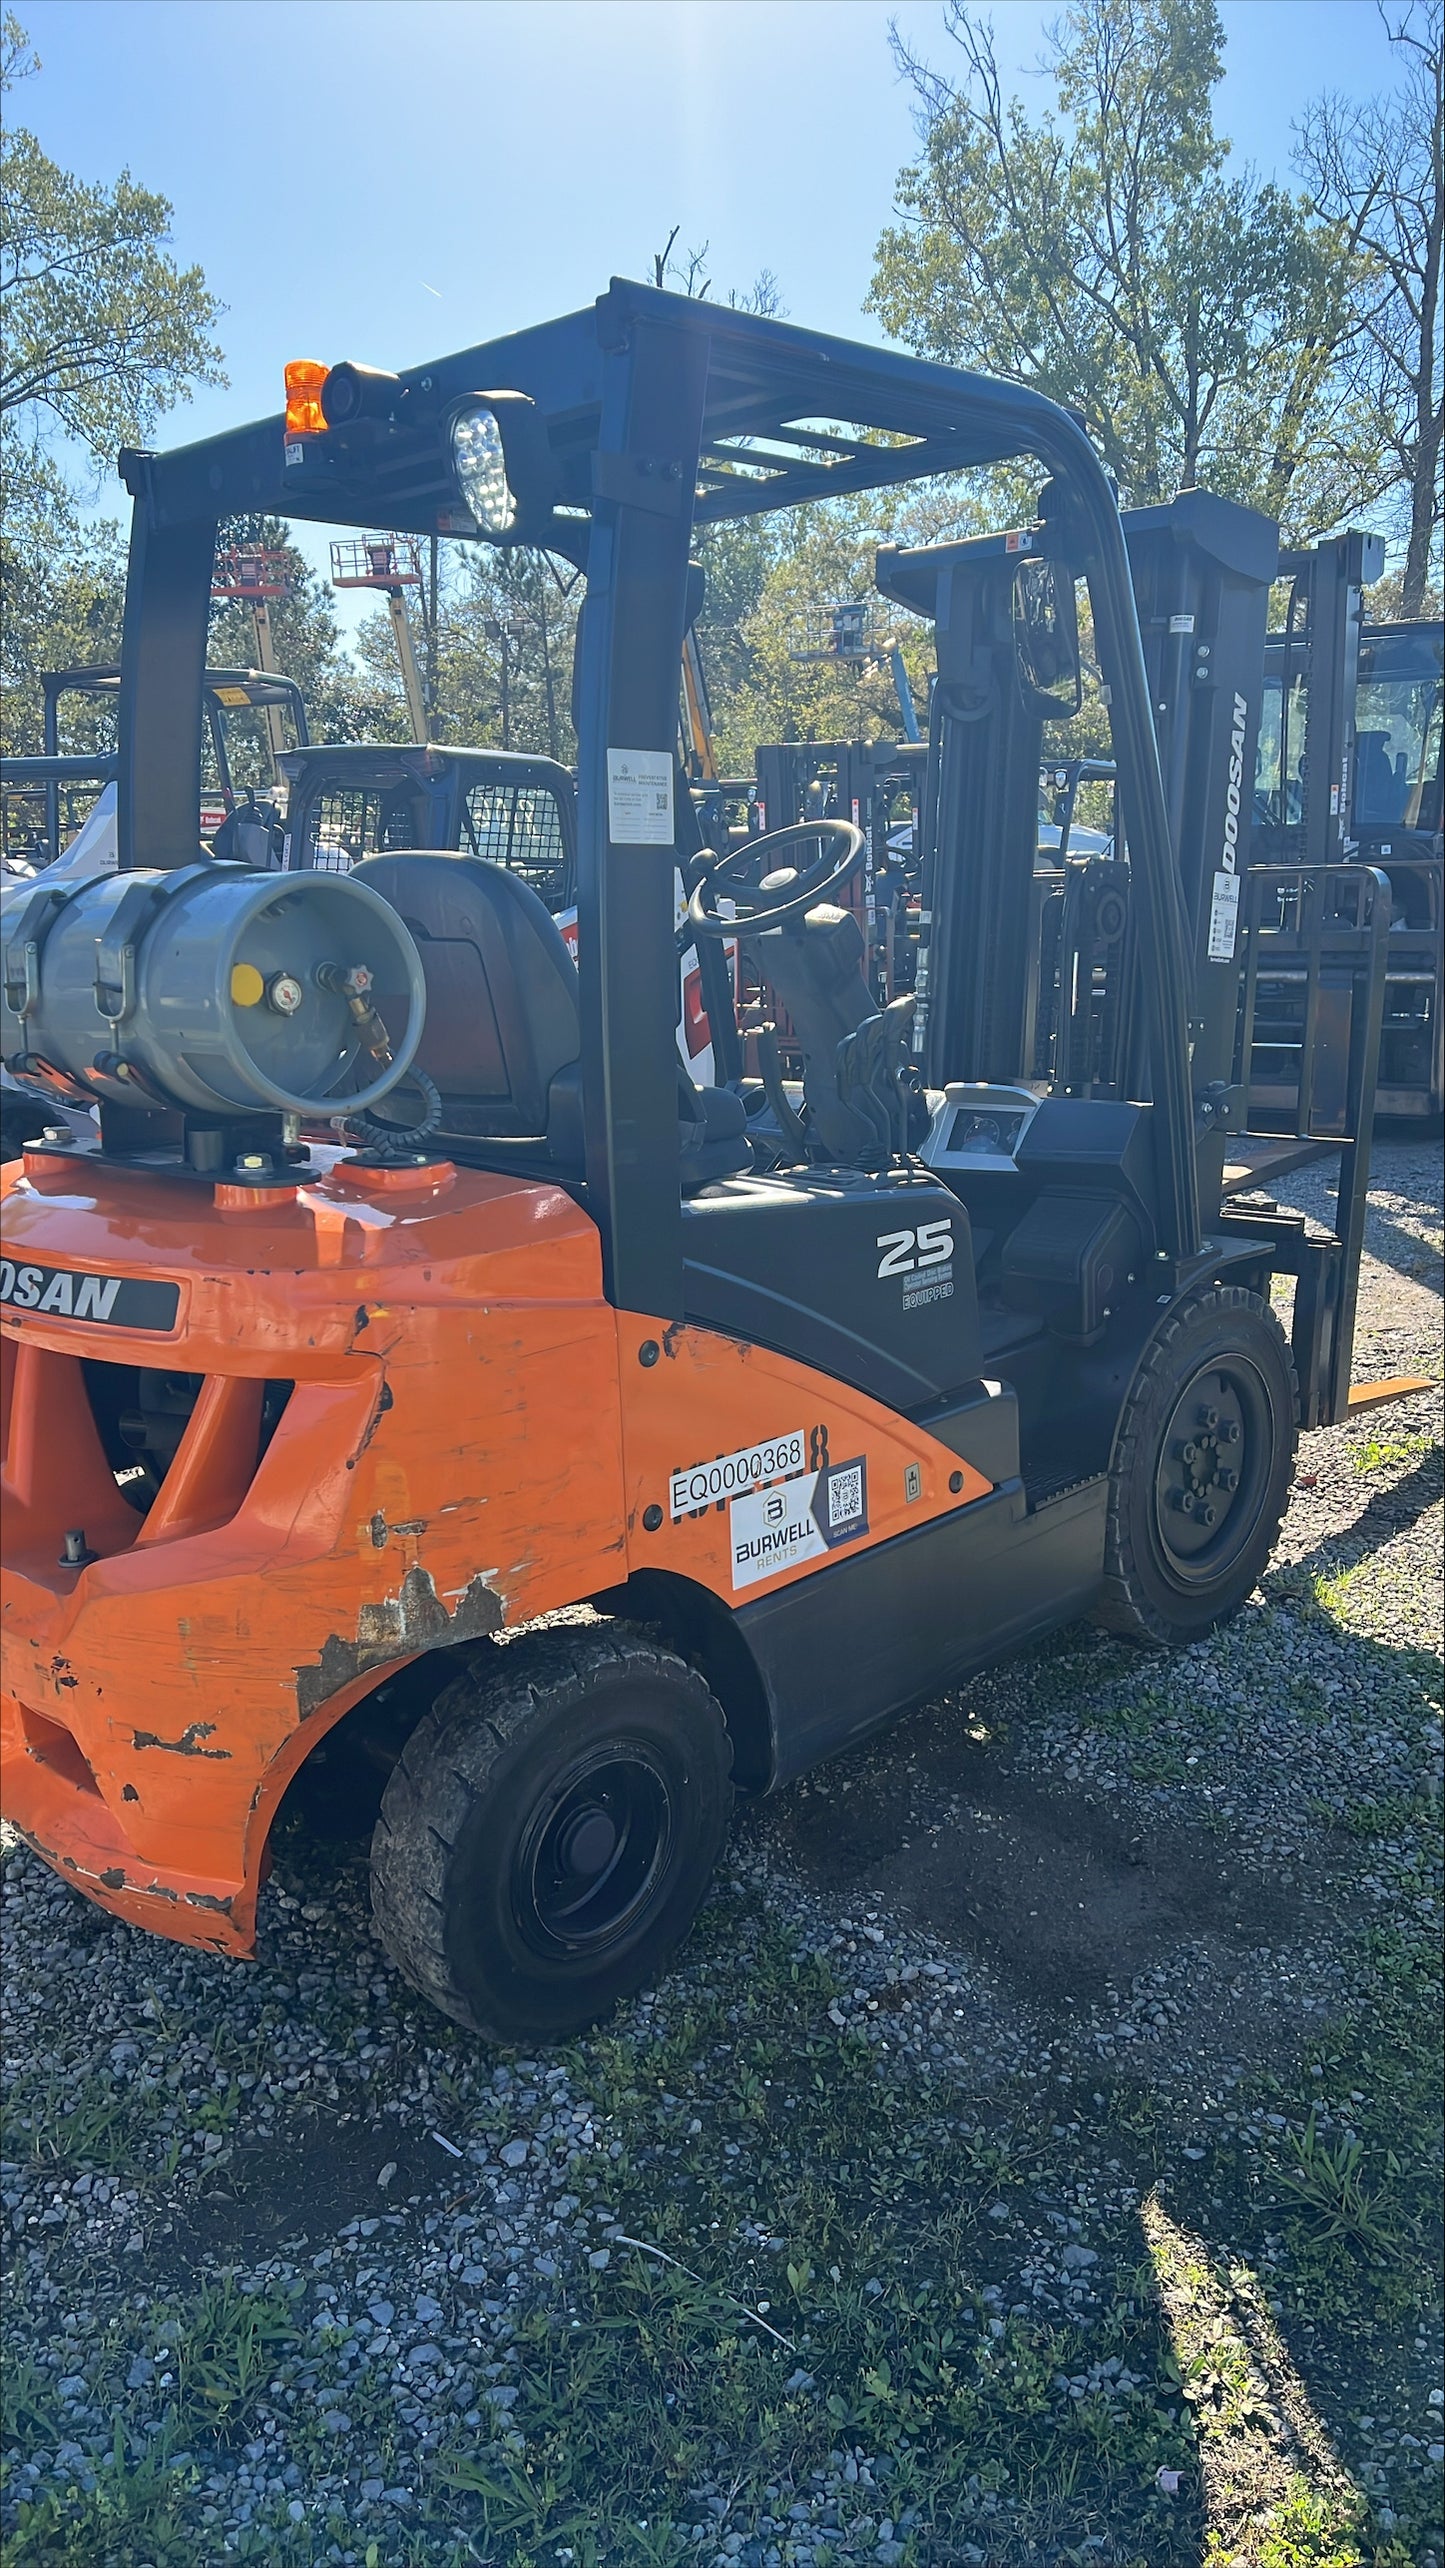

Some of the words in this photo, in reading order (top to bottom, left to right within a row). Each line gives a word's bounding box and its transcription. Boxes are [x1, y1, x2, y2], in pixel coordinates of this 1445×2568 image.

[1222, 692, 1247, 874] DOOSAN
[865, 825, 873, 871] Bobcat
[877, 1218, 954, 1279] 25
[902, 1281, 954, 1311] EQUIPPED
[673, 1439, 801, 1509] EQ0000368
[736, 1518, 815, 1563] BURWELL
[833, 1526, 848, 1538] SCAN
[756, 1545, 798, 1570] RENTS
